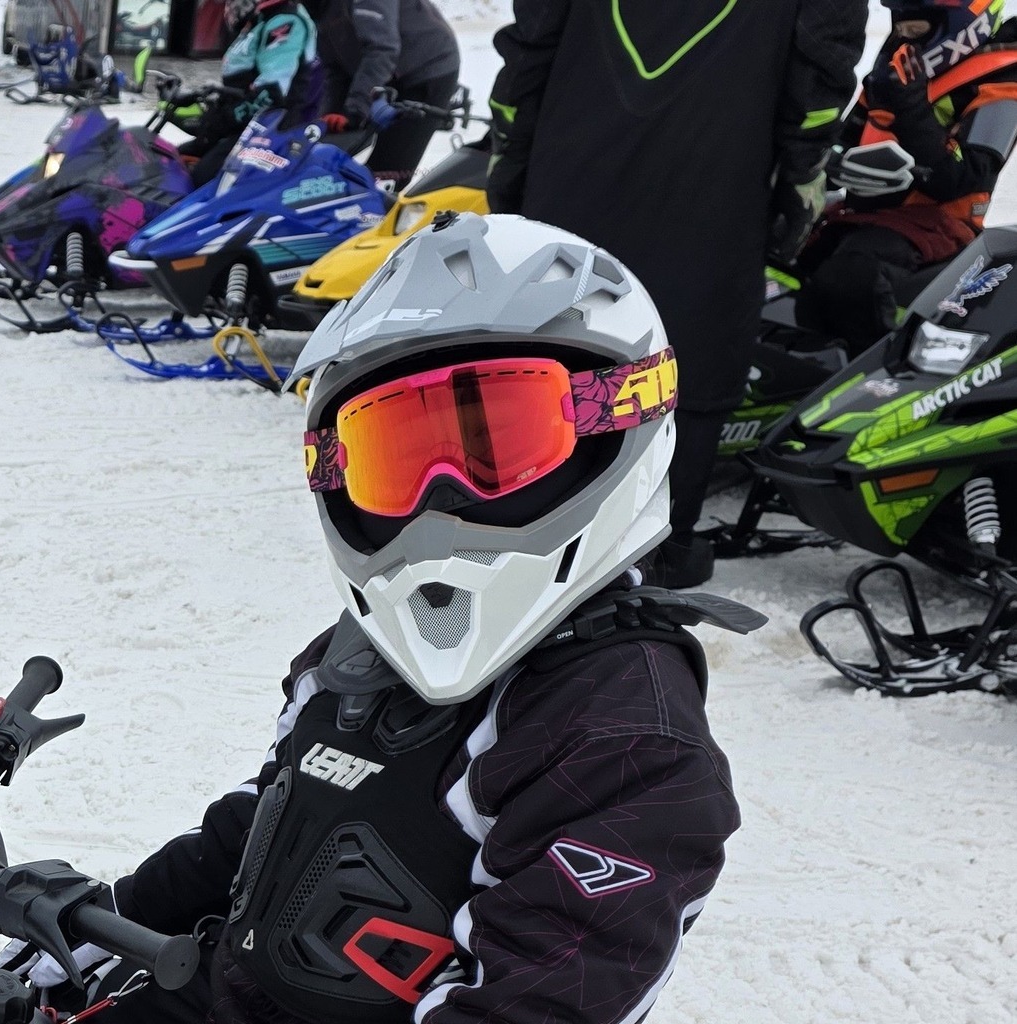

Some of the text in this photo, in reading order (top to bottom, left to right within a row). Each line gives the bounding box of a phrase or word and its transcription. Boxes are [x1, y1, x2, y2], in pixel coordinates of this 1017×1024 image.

[921, 13, 993, 79] FXR
[912, 357, 1003, 421] ARCTIC CAT
[556, 630, 574, 640] OPEN
